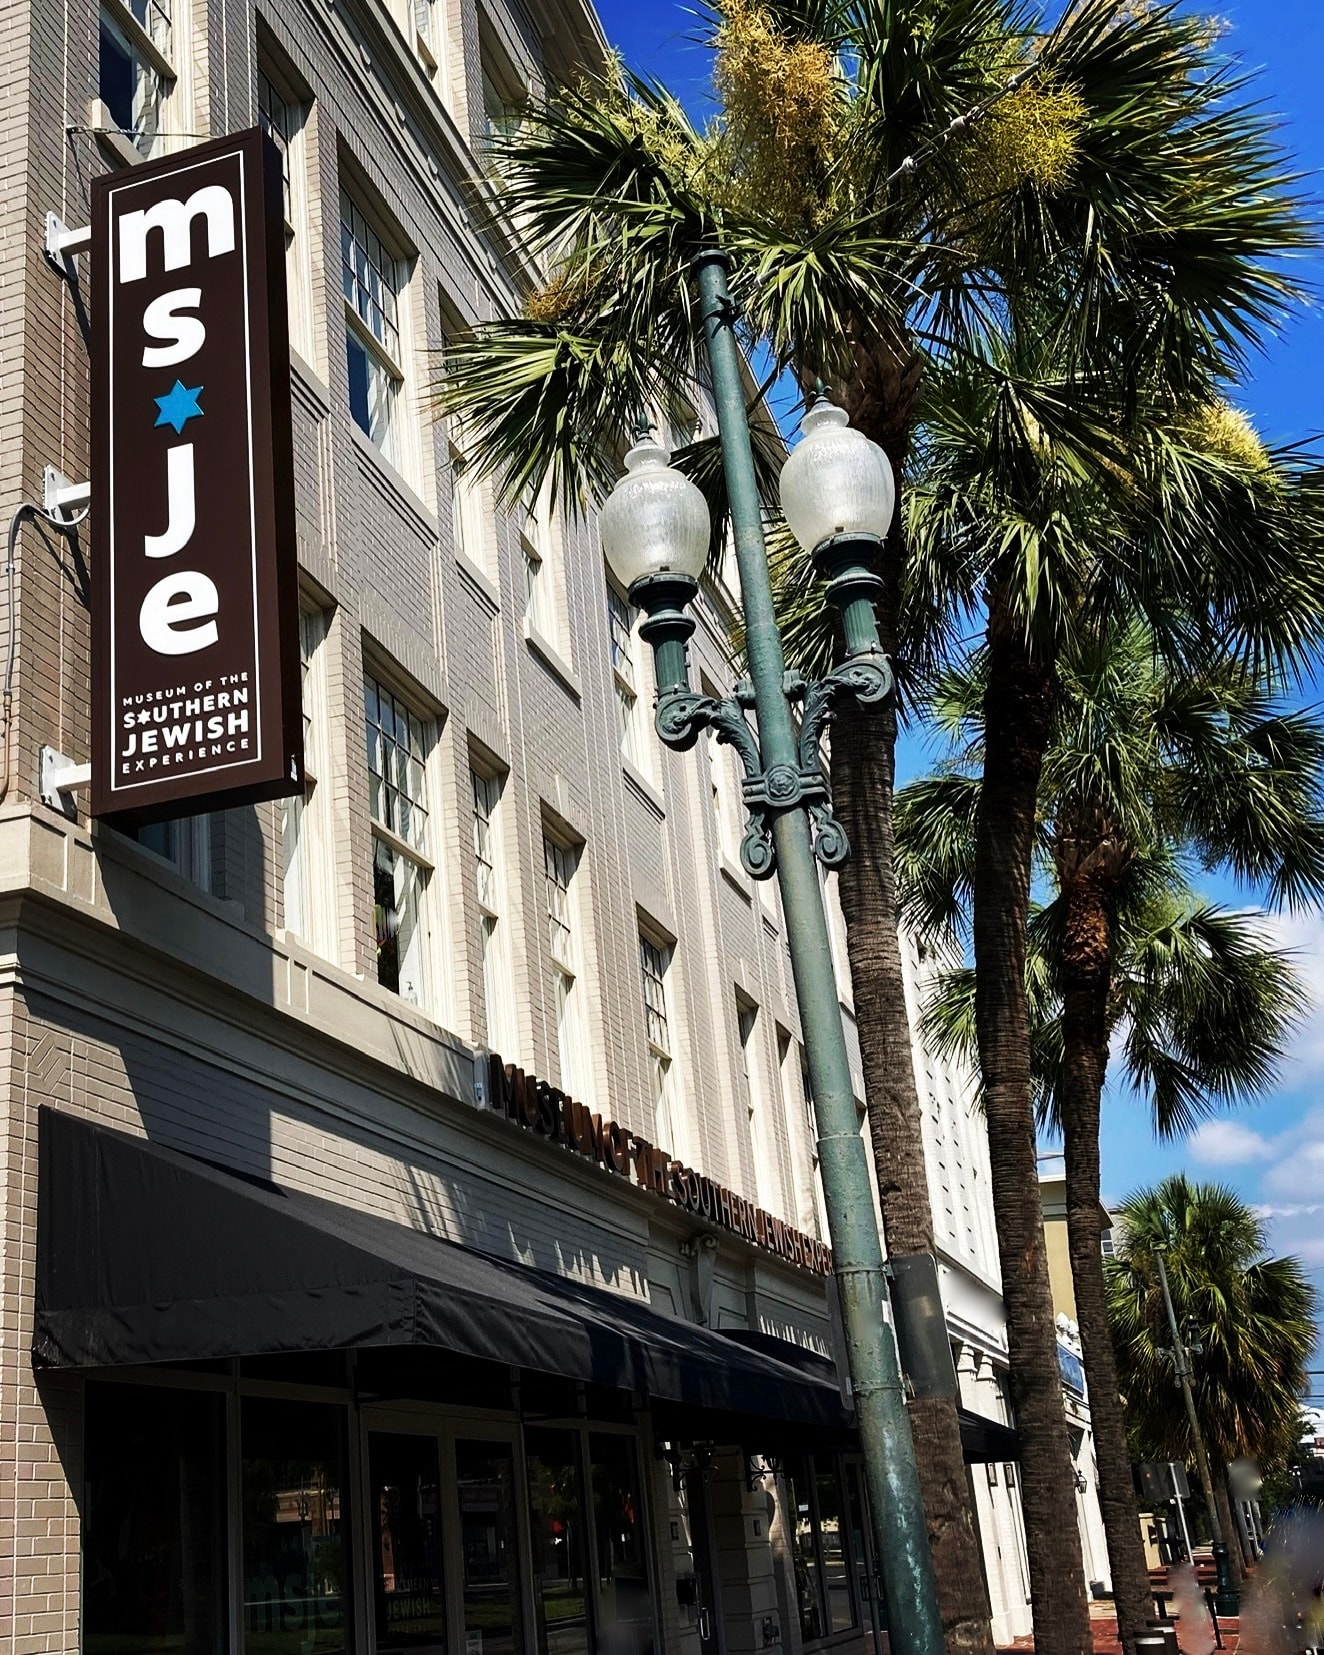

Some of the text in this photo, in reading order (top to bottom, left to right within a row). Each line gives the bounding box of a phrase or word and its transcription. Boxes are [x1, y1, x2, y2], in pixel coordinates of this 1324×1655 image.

[122, 671, 249, 706] MUSEUM OF THE
[122, 687, 249, 729] SUTHERN
[122, 709, 249, 757] JEWISH
[122, 737, 249, 775] EXPERIENCE
[489, 1053, 603, 1161] MUSEUM
[670, 1160, 759, 1242] SOUTHERN
[755, 1208, 805, 1264] JEWISH
[387, 1596, 431, 1620] JEWISH
